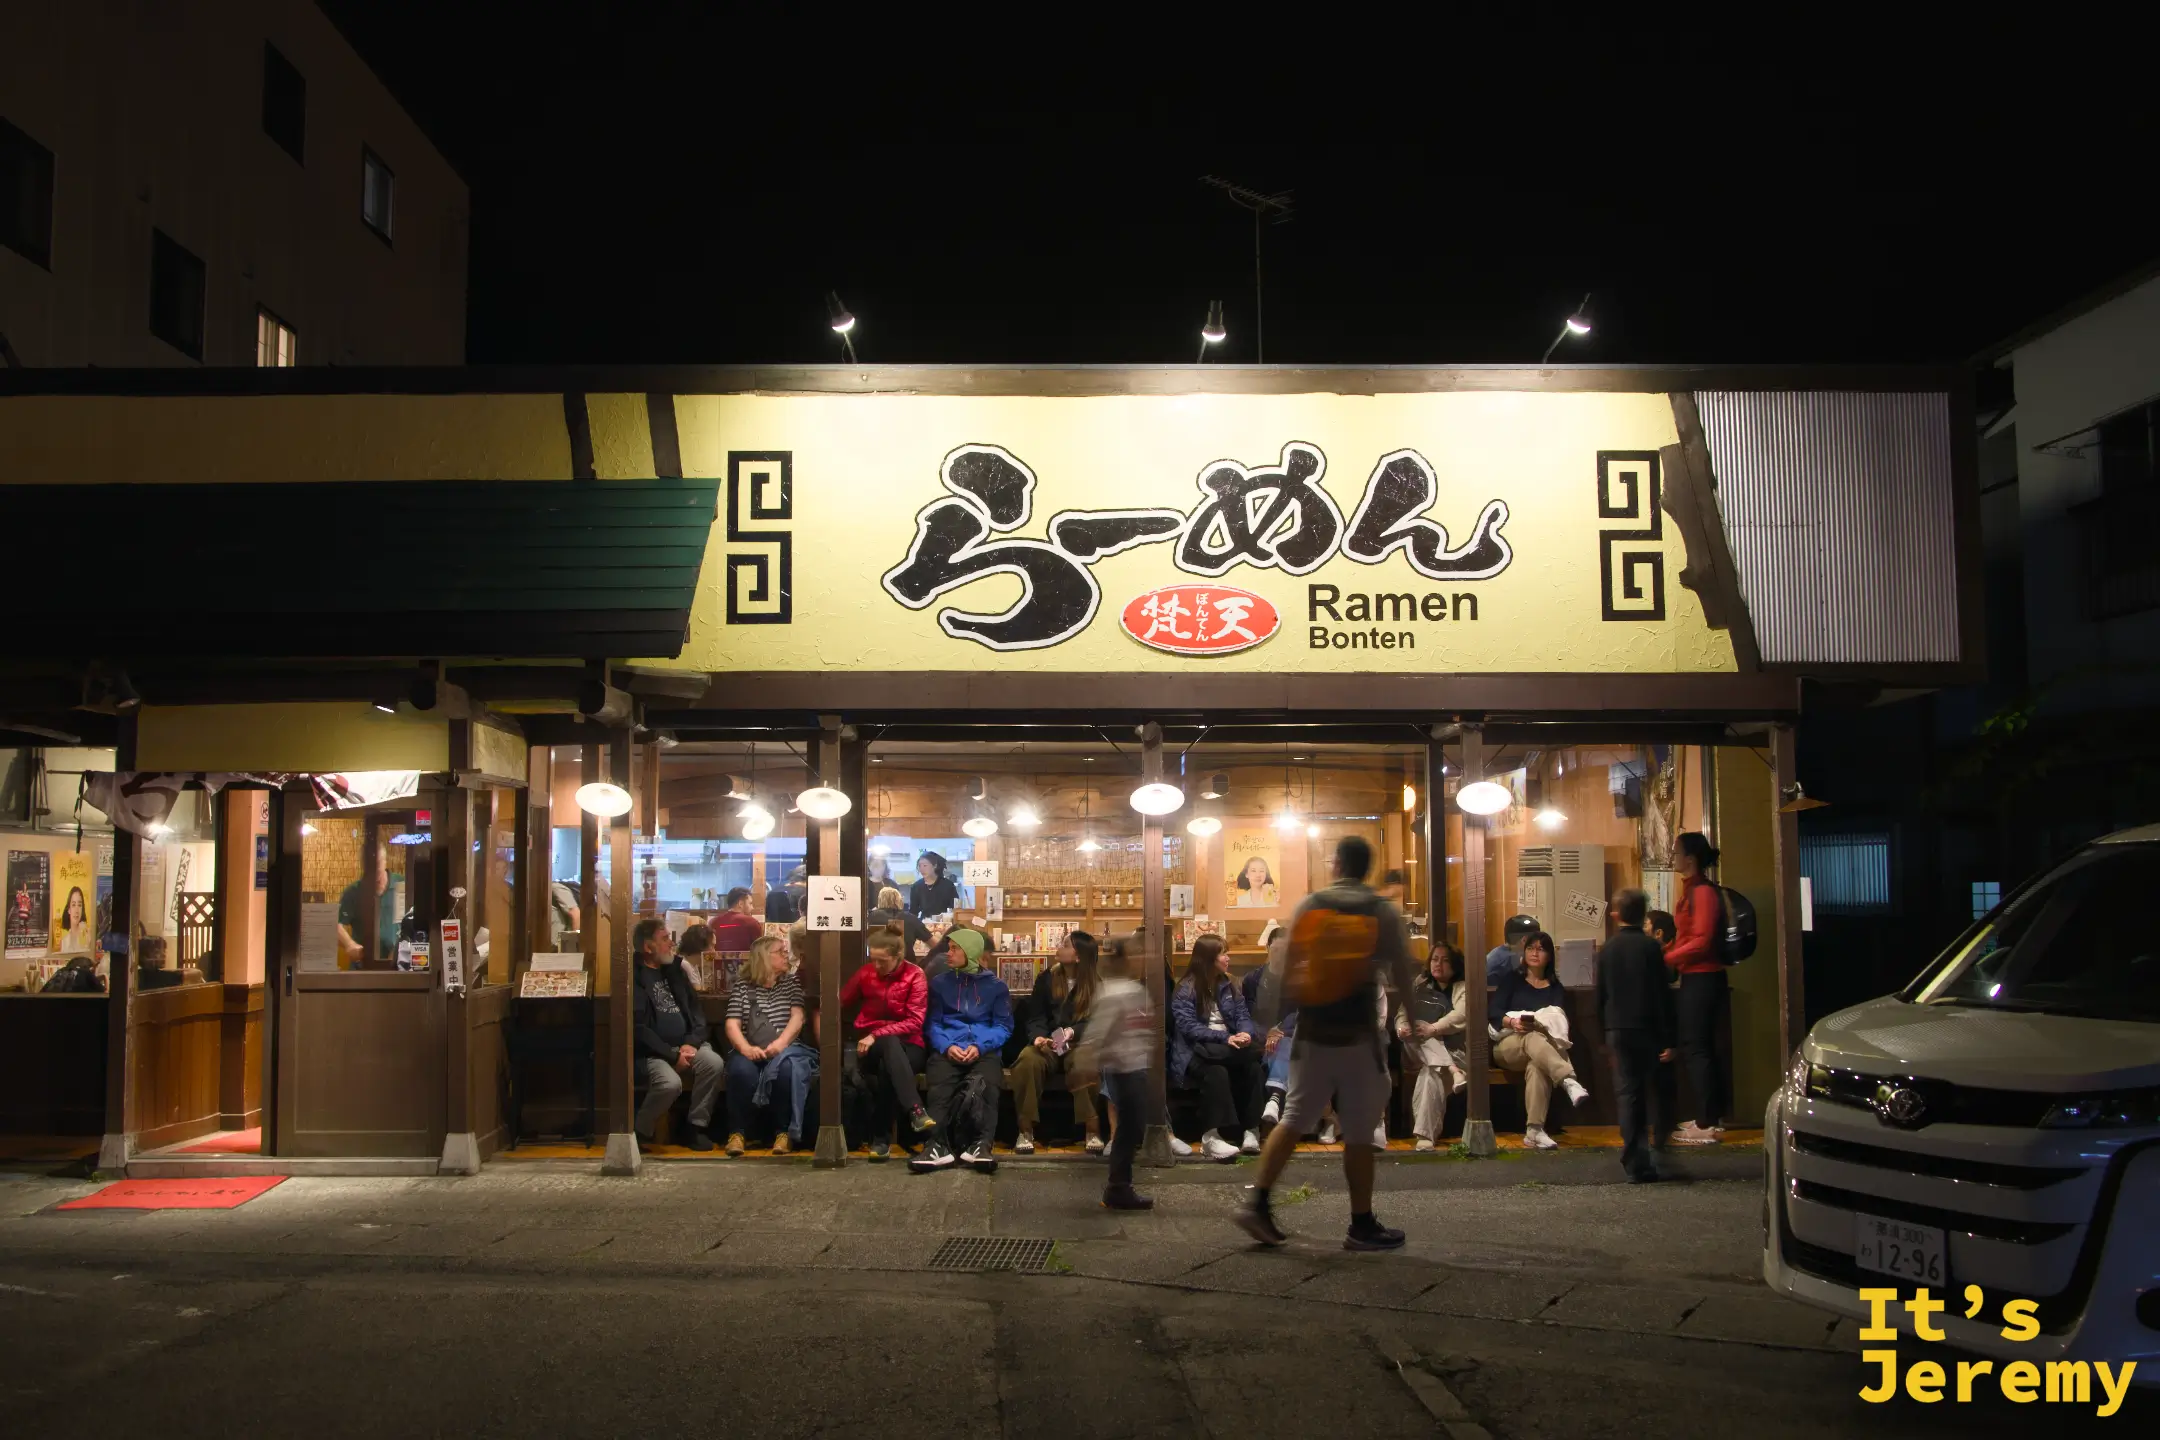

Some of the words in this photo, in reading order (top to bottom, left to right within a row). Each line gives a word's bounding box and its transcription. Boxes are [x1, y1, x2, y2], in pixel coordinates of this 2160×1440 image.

[881, 441, 1512, 652] らーめん
[1141, 595, 1257, 640] 梵天
[1195, 592, 1210, 642] ぼんてん
[1308, 583, 1478, 622] Ramen
[1309, 626, 1414, 649] Bonten
[972, 867, 992, 878] お水
[816, 915, 853, 927] 禁煙
[1574, 900, 1598, 916] お水
[447, 946, 458, 985] 営業中
[1878, 1239, 1940, 1282] 12-96
